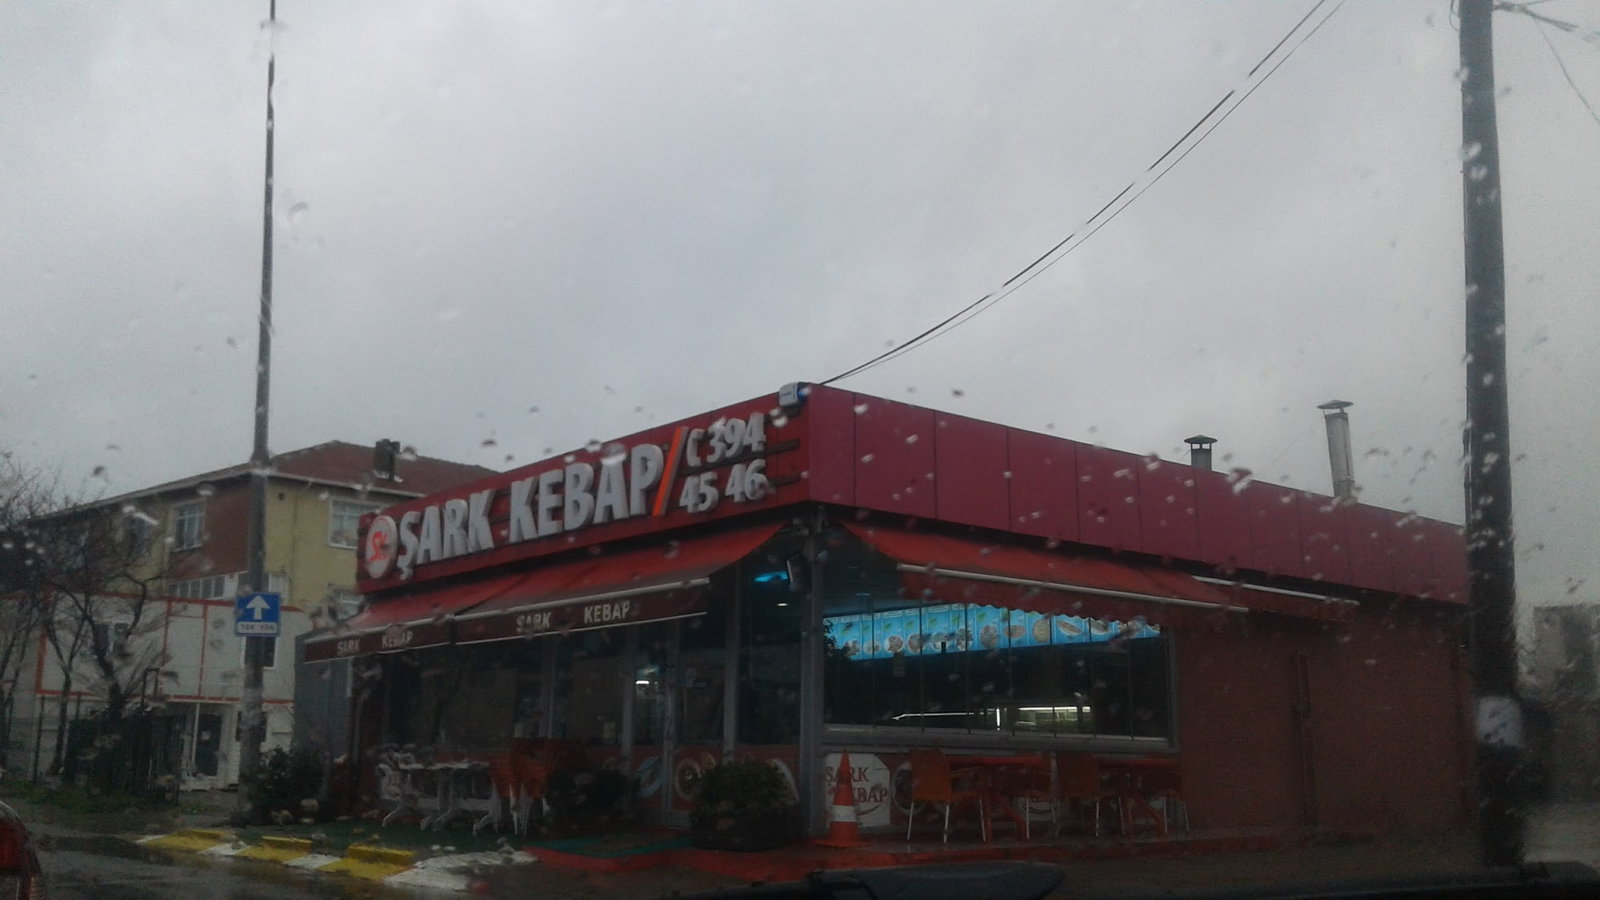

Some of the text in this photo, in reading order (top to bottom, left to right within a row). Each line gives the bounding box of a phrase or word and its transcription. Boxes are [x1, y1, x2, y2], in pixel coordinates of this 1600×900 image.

[707, 412, 766, 463] 394
[679, 458, 769, 513] 45 46
[397, 444, 665, 581] ŞARK KEBAP
[584, 600, 630, 624] KEBAP
[382, 631, 414, 648] KEAP
